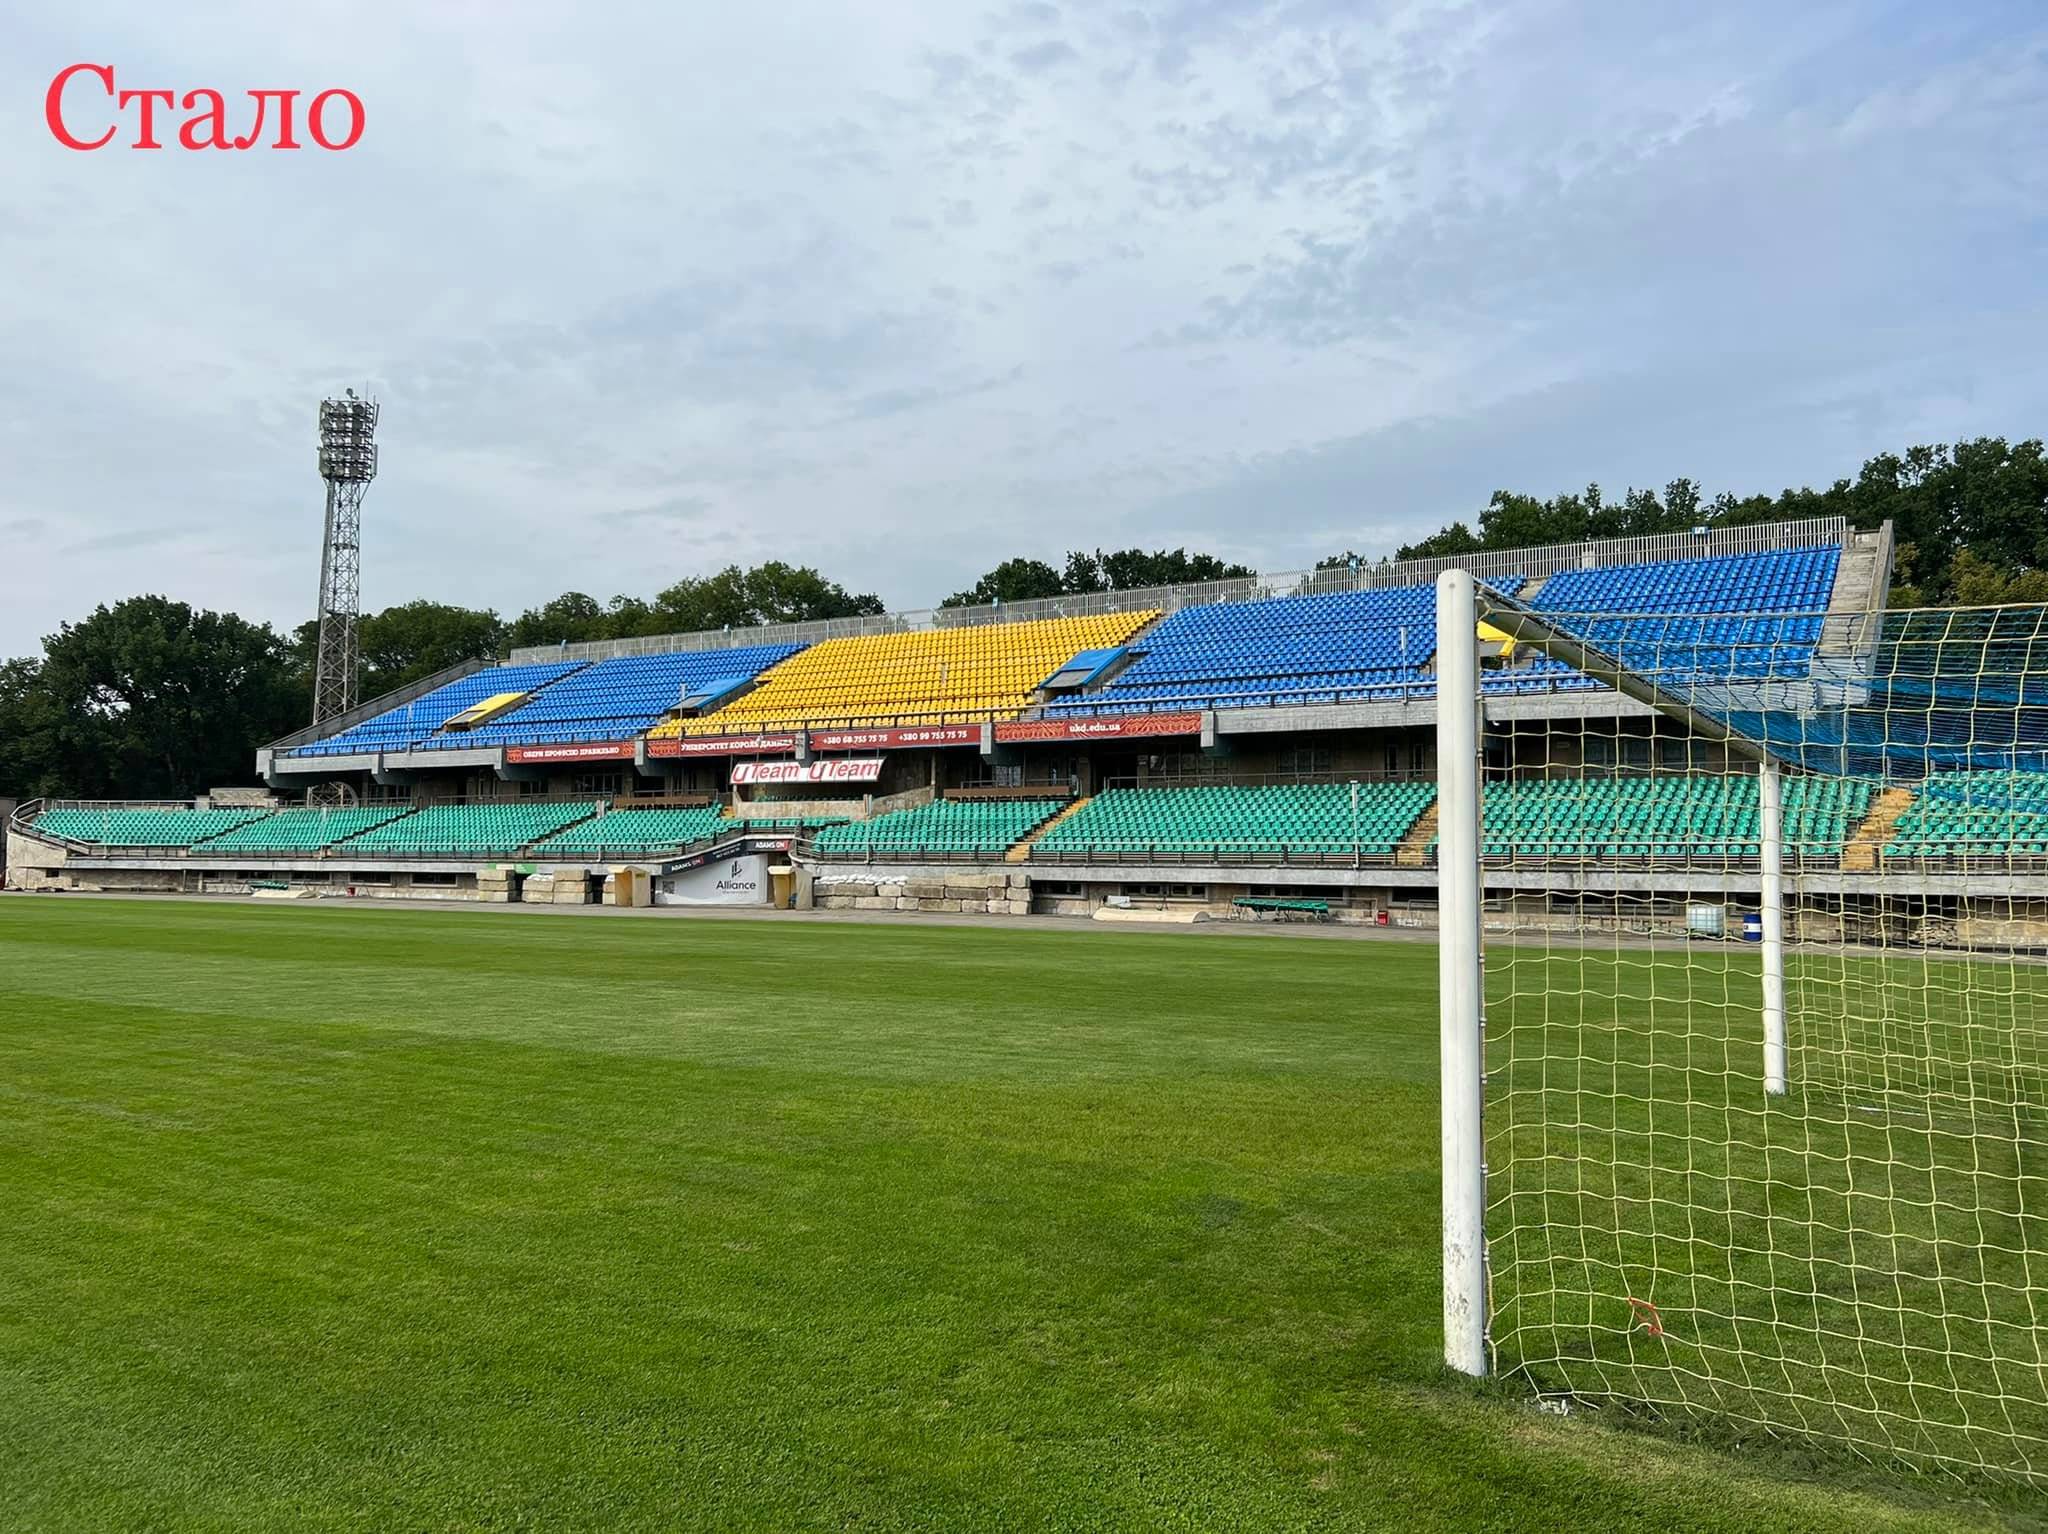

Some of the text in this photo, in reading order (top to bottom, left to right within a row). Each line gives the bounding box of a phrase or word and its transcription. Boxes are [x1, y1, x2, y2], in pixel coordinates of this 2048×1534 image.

[1069, 723, 1121, 733] ukd.edu.ua
[823, 736, 841, 745] +380
[853, 734, 867, 744] 755
[868, 734, 877, 743] 75
[878, 733, 889, 742] 75
[898, 731, 917, 741] +380
[946, 730, 956, 739] 75
[957, 729, 968, 738] 75
[716, 880, 757, 890] Alliance
